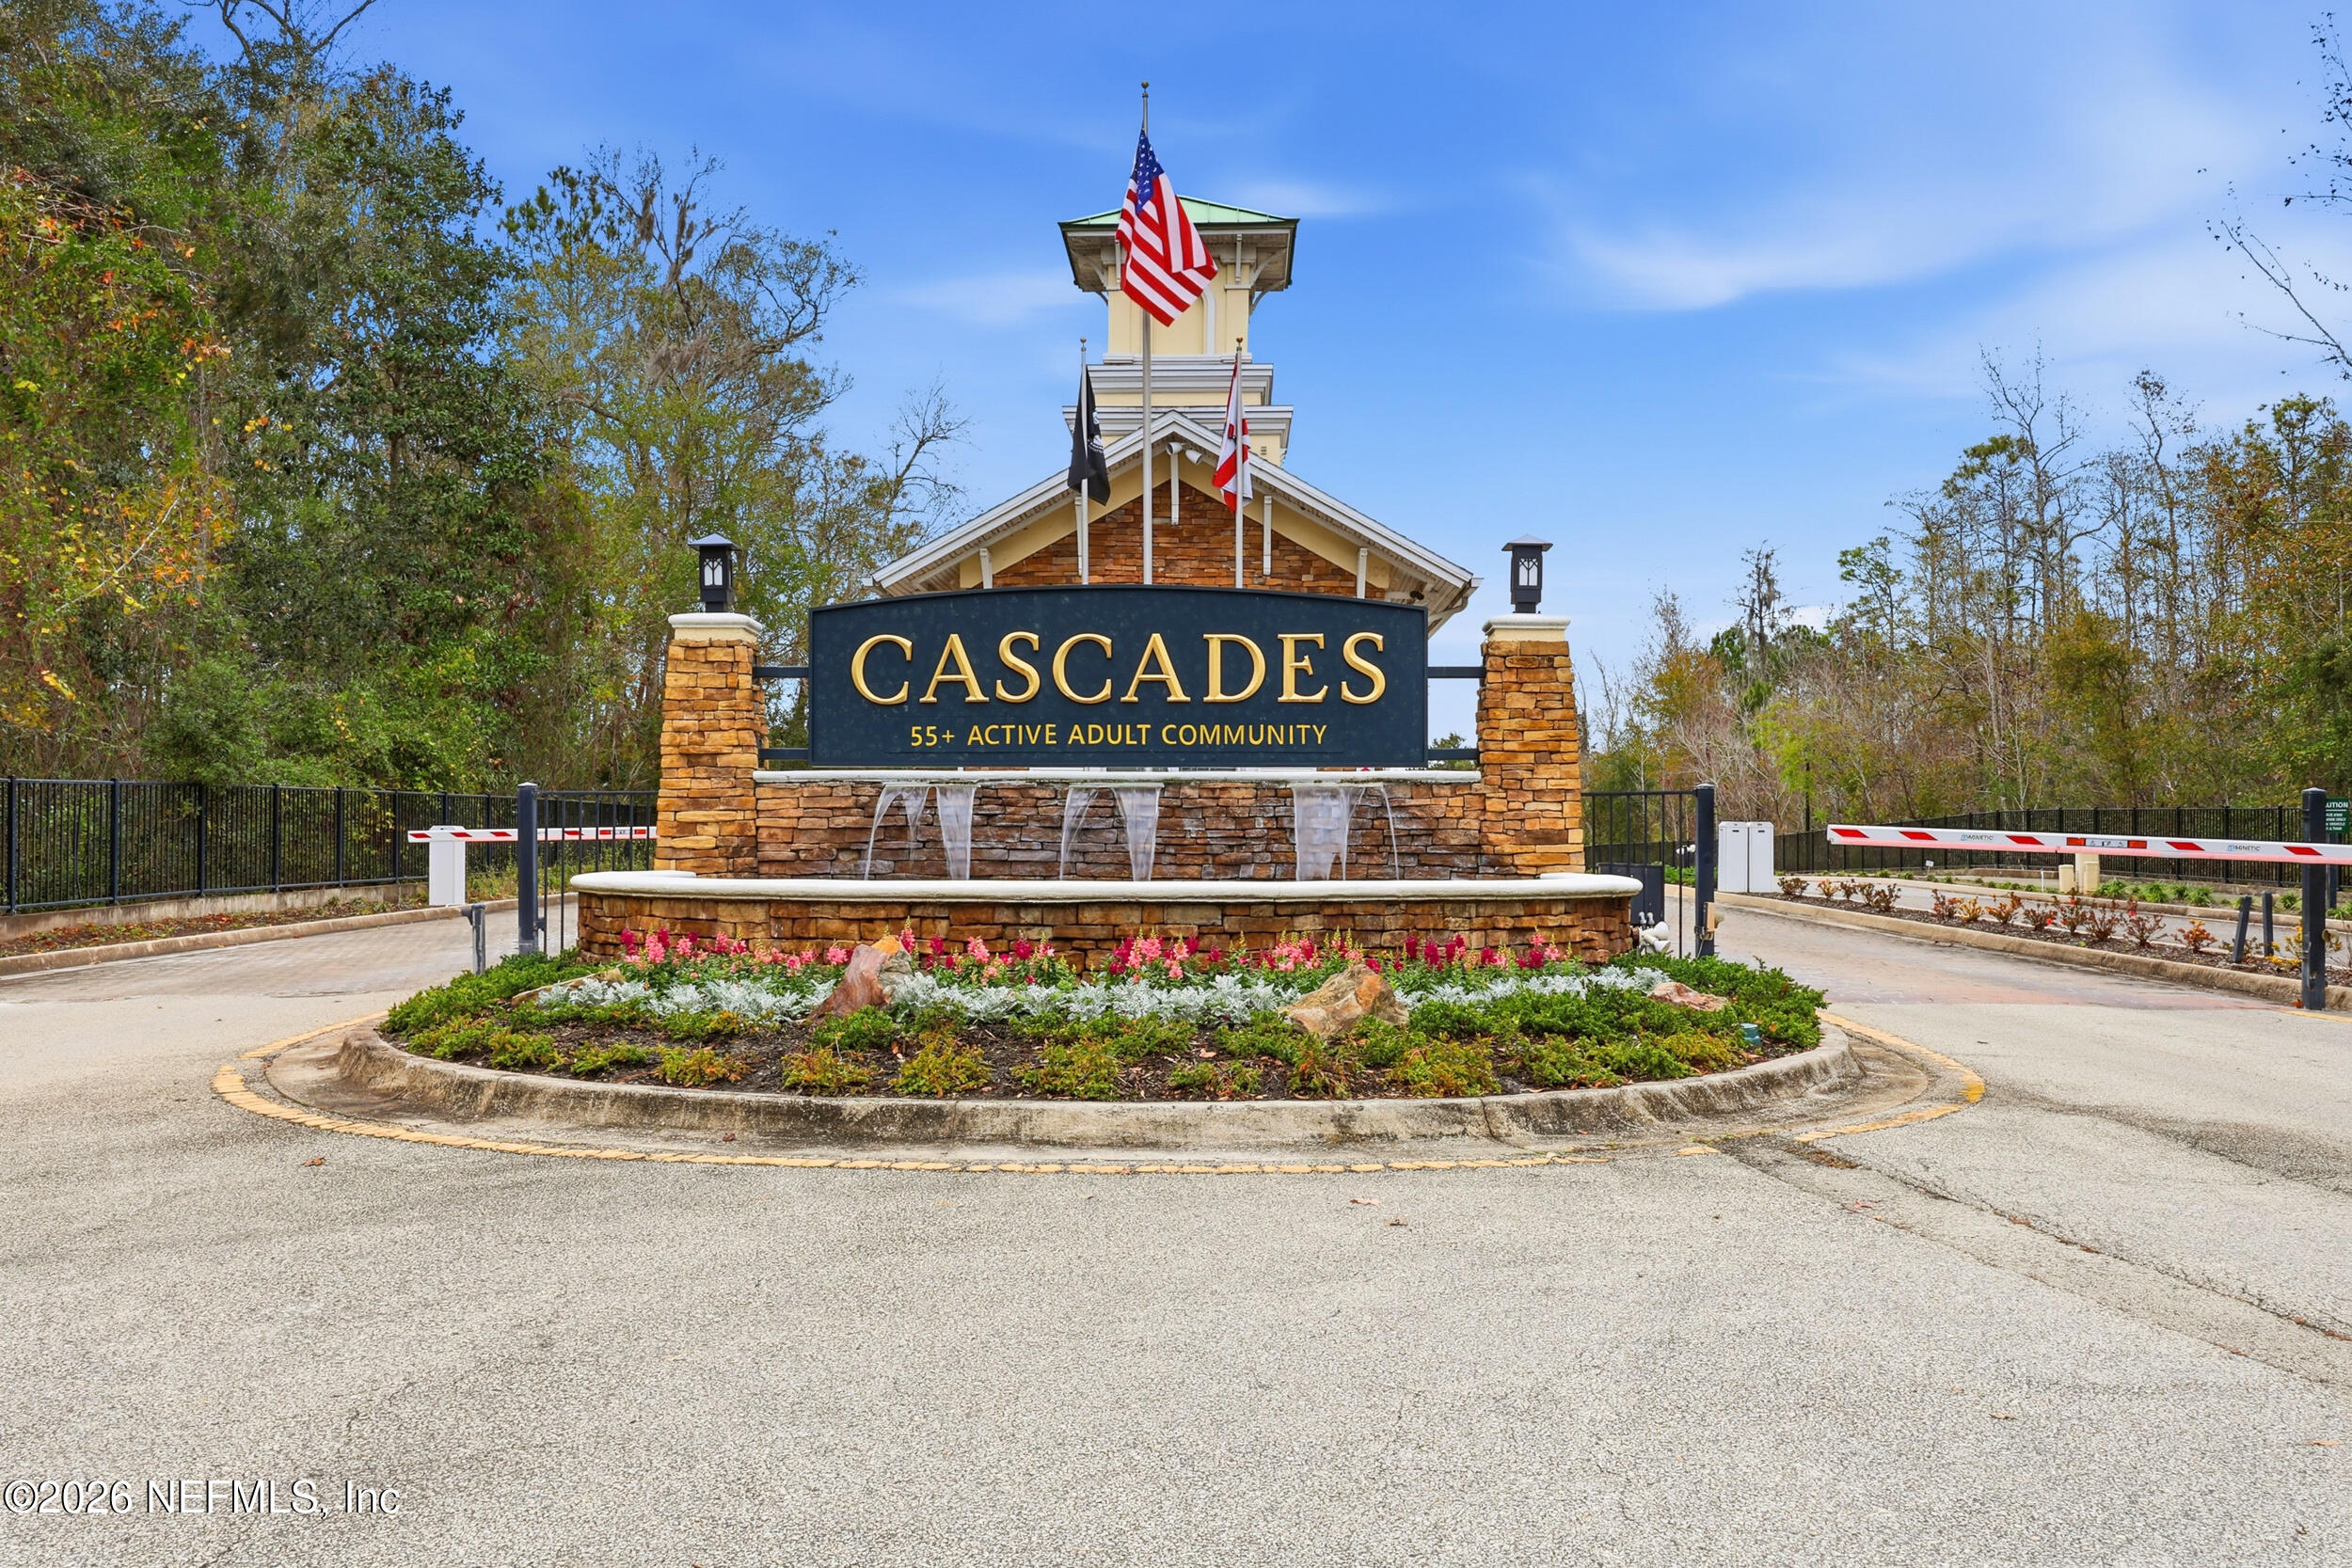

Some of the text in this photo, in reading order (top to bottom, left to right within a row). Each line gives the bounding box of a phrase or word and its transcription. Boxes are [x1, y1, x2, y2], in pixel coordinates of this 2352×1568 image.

[850, 631, 1388, 705] CASCADES
[910, 723, 1327, 747] 55+ ACTIVE ADULT COMMUNITY
